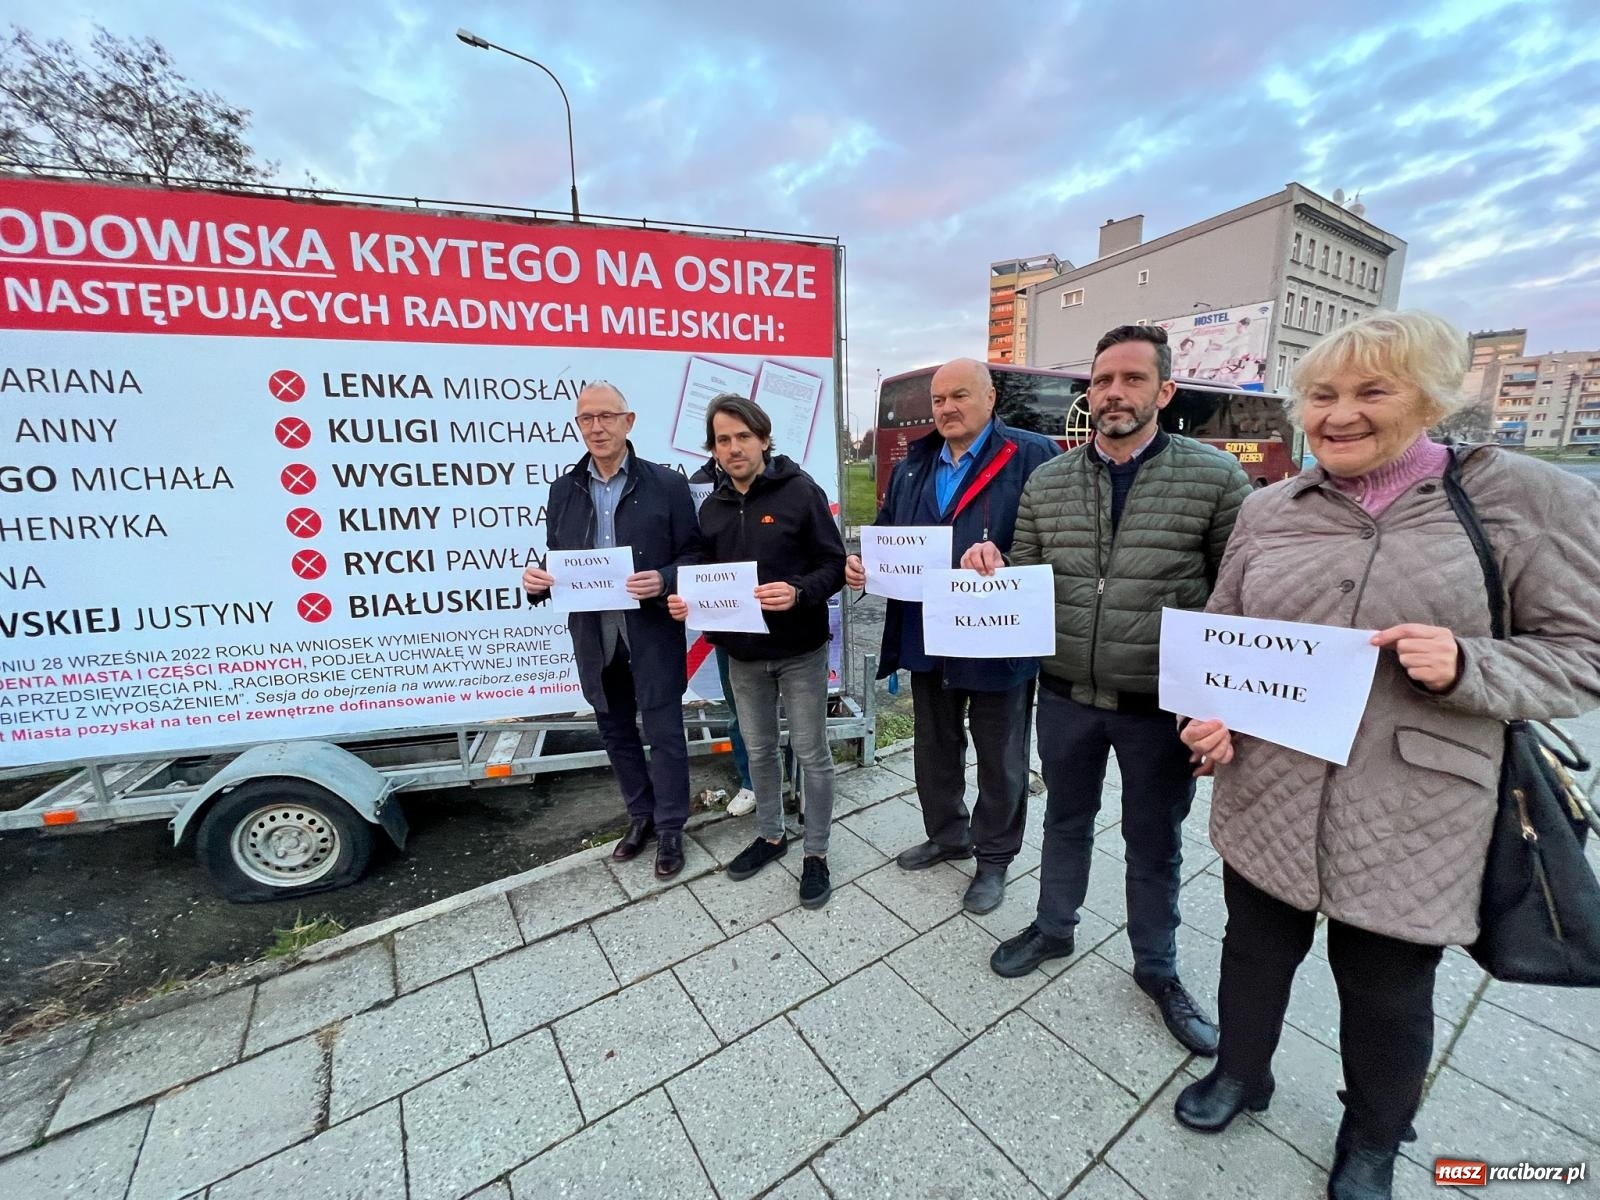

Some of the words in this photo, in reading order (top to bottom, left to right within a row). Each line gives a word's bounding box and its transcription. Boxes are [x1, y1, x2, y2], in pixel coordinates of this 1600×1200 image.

[0, 208, 335, 270] ODOWISKA
[350, 231, 580, 285] KRYTEGO
[596, 249, 662, 289] NA
[674, 256, 816, 299] OSIRZE
[4, 278, 390, 329] NASTĘPUJĄCYCH
[404, 296, 589, 334] RADNYCH
[602, 306, 785, 342] MIEJSKICH:
[1194, 312, 1230, 327] HOSTEL
[1, 368, 143, 394] ARIANA
[323, 372, 433, 399] LENKA
[16, 418, 117, 443] ANNY
[328, 418, 438, 443] KULIGI
[450, 421, 579, 443] MICHAŁA
[72, 466, 234, 491] MICHAŁA
[332, 462, 515, 488] WYGLENDY
[0, 514, 168, 541] HENRYKA
[339, 506, 440, 532] KLIMY
[452, 506, 548, 529] PIOTRA
[877, 535, 927, 546] POLOWY
[344, 550, 435, 575] RYCKI
[446, 547, 541, 571] PAWŁA
[564, 556, 611, 567] POLOWY
[879, 563, 924, 575] KŁAMIE
[695, 571, 737, 583] POLOWY
[951, 578, 1022, 593] POLOWY
[134, 601, 273, 631] JUSTYNY
[349, 587, 521, 618] BIAŁUSKIEJ
[955, 614, 1020, 627] KŁAMIE
[0, 659, 35, 673] NIU
[42, 657, 63, 671] 28
[68, 650, 168, 668] WRZEŚNIA
[171, 648, 211, 661] 2022
[216, 644, 264, 658] ROKU
[270, 642, 293, 654] NA
[297, 637, 374, 652] WNIOSEK
[378, 628, 499, 647] WYMIENIONYCH
[1203, 628, 1321, 656] POLOWY
[0, 675, 57, 690] ENTA
[62, 669, 132, 686] MIASTA
[137, 669, 142, 679] I
[148, 662, 213, 680] CZĘŚCI
[218, 658, 307, 674] RADNYCH,
[312, 652, 385, 667] PODJEŁA
[388, 645, 463, 662] UCHWAŁĘ
[468, 645, 482, 656] W
[487, 640, 551, 654] SPRAWIE
[18, 682, 189, 706] PRZEDSIĘWZIĘCIA
[193, 680, 222, 692] PN.
[228, 670, 346, 691] „RACIBORSKIE
[351, 664, 428, 680] CENTRUM
[432, 658, 512, 674] AKTYWNEJ
[76, 707, 87, 719] Z
[255, 690, 296, 704] Sesja
[301, 689, 318, 700] do
[324, 682, 396, 699] obejrzenia
[401, 682, 418, 691] na
[423, 668, 570, 690] www.raciborz.esesja.pl
[1205, 672, 1307, 702] KŁAMIE
[12, 726, 71, 741] Miasta
[78, 718, 155, 738] pozyskał
[161, 718, 181, 728] na
[186, 715, 212, 725] ten
[218, 710, 241, 722] cel
[246, 704, 334, 720] zewnętrzne
[340, 692, 456, 712] dofinansowanie
[460, 692, 471, 701] w
[476, 688, 523, 700] kwocie
[528, 685, 535, 695] 4
